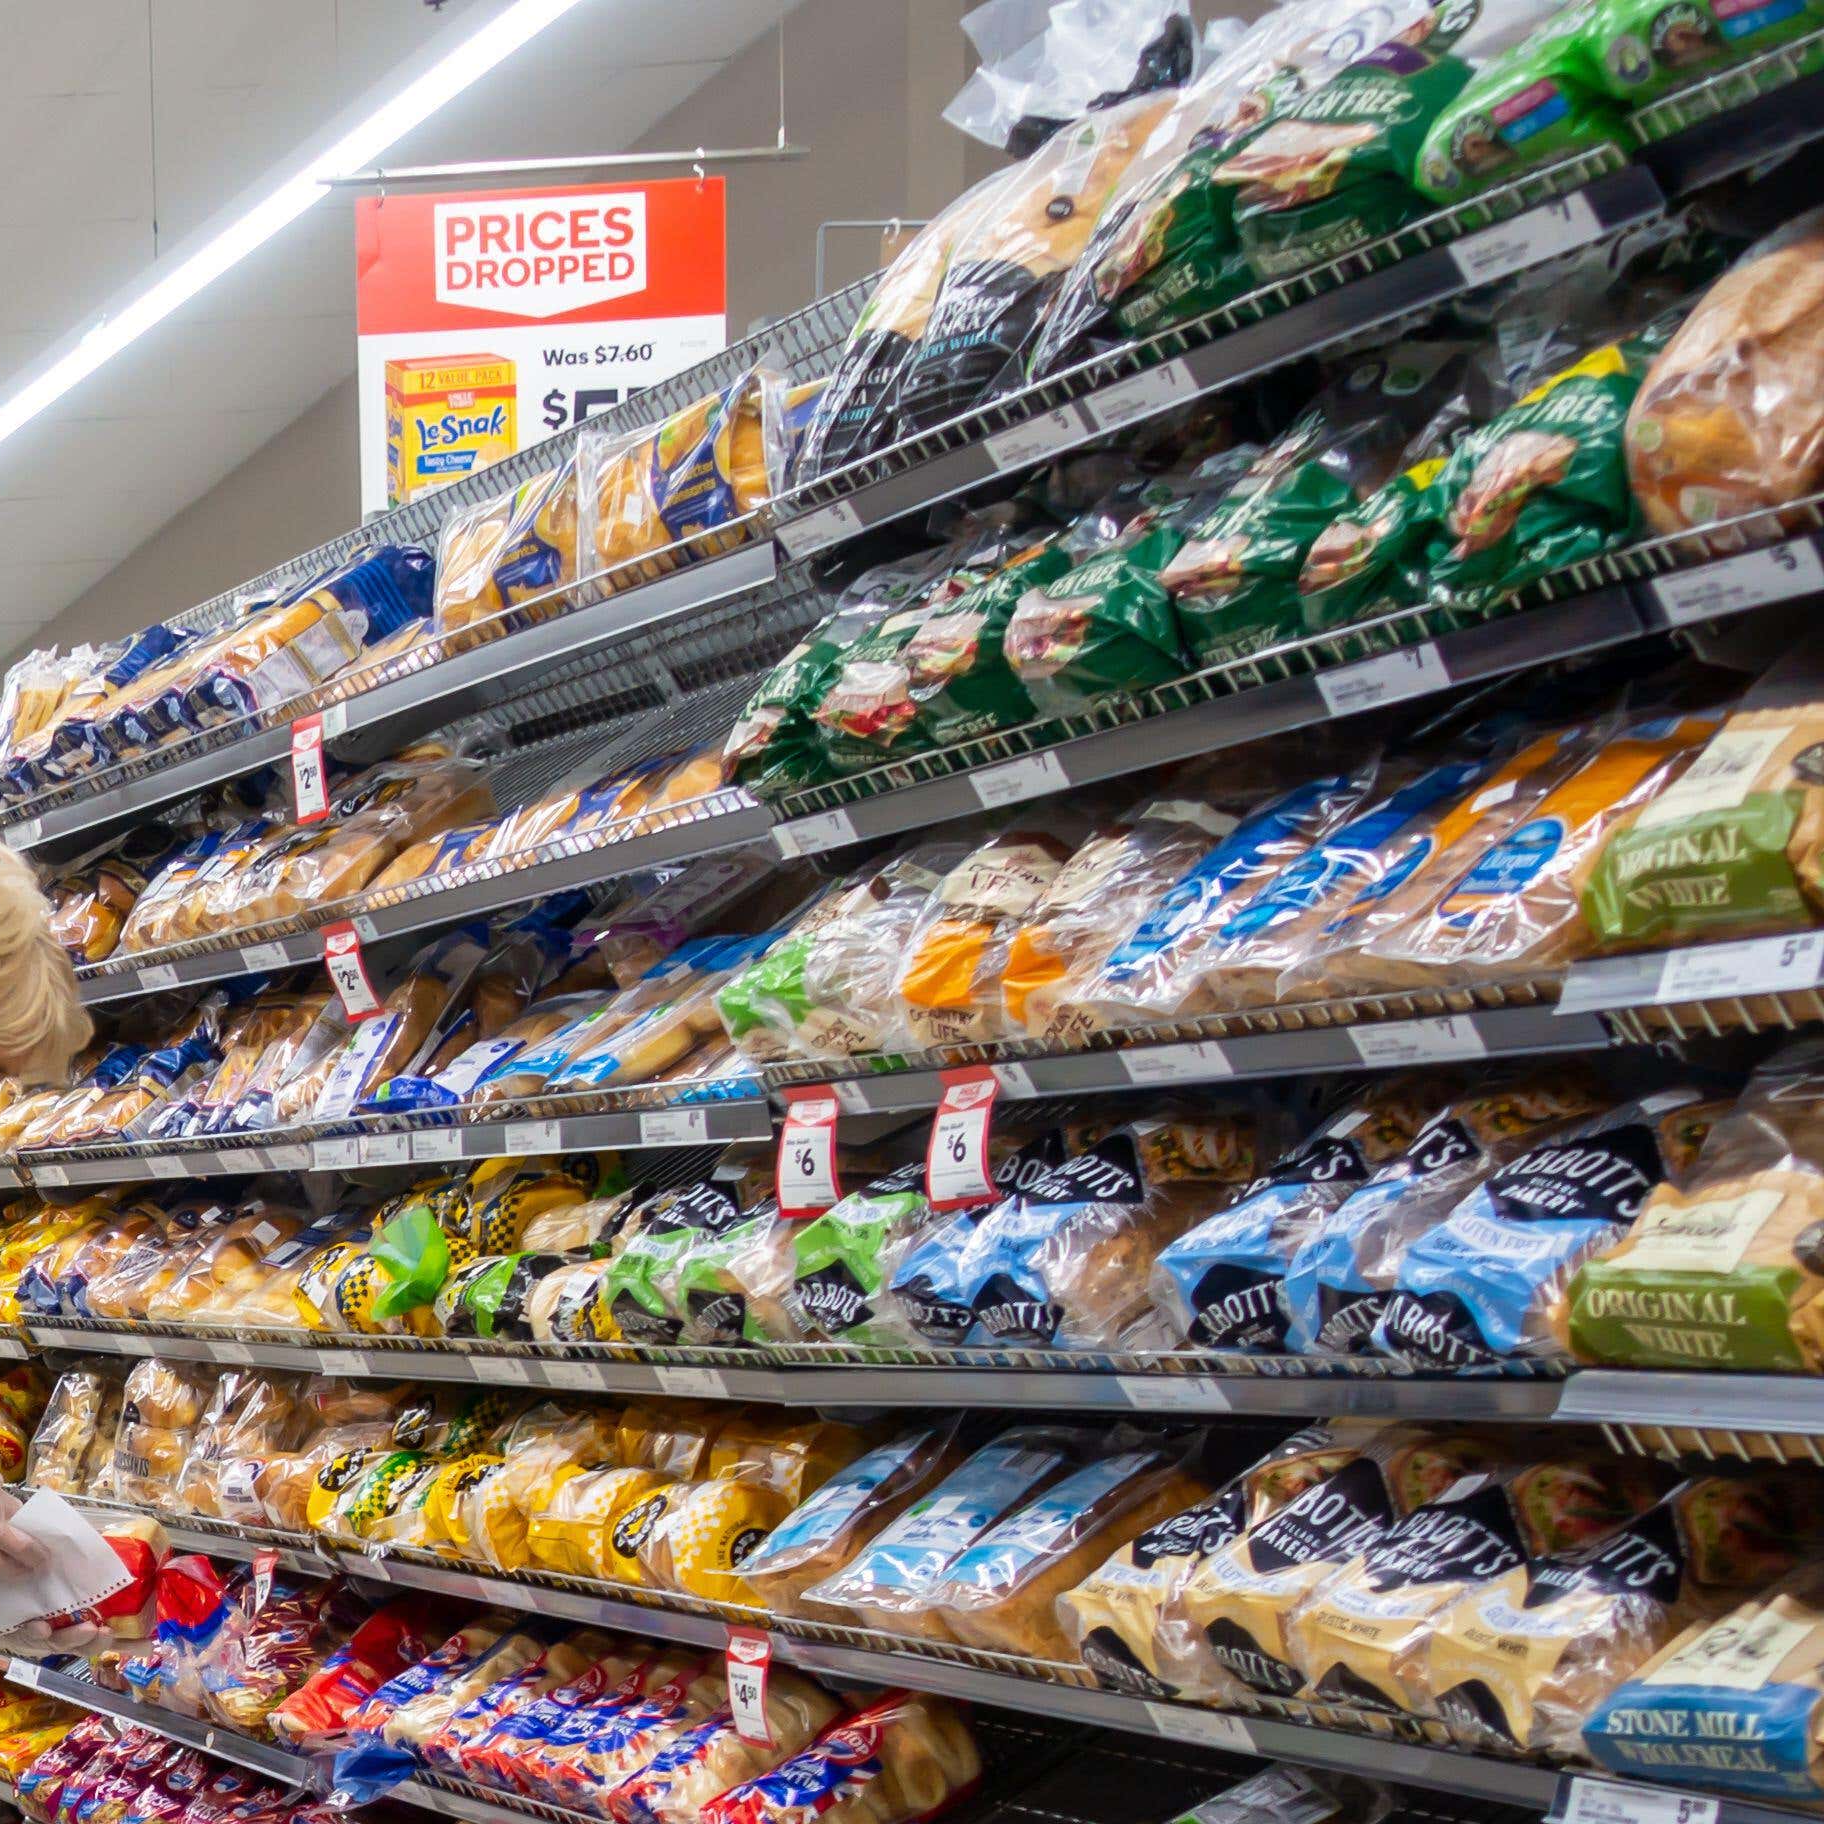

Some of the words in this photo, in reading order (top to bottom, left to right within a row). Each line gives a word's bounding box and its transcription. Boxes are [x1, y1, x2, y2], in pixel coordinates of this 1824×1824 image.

[445, 206, 633, 256] PRICES
[447, 252, 635, 291] DROPPED
[542, 349, 589, 368] Was
[595, 342, 654, 364] $7.60
[795, 1148, 815, 1176] $6
[947, 1131, 967, 1163] $6
[1586, 1285, 1749, 1326] ORIGINAL
[1622, 1323, 1733, 1361] WHITE
[1605, 1710, 1690, 1736] STONE
[1696, 1710, 1765, 1741] MILL
